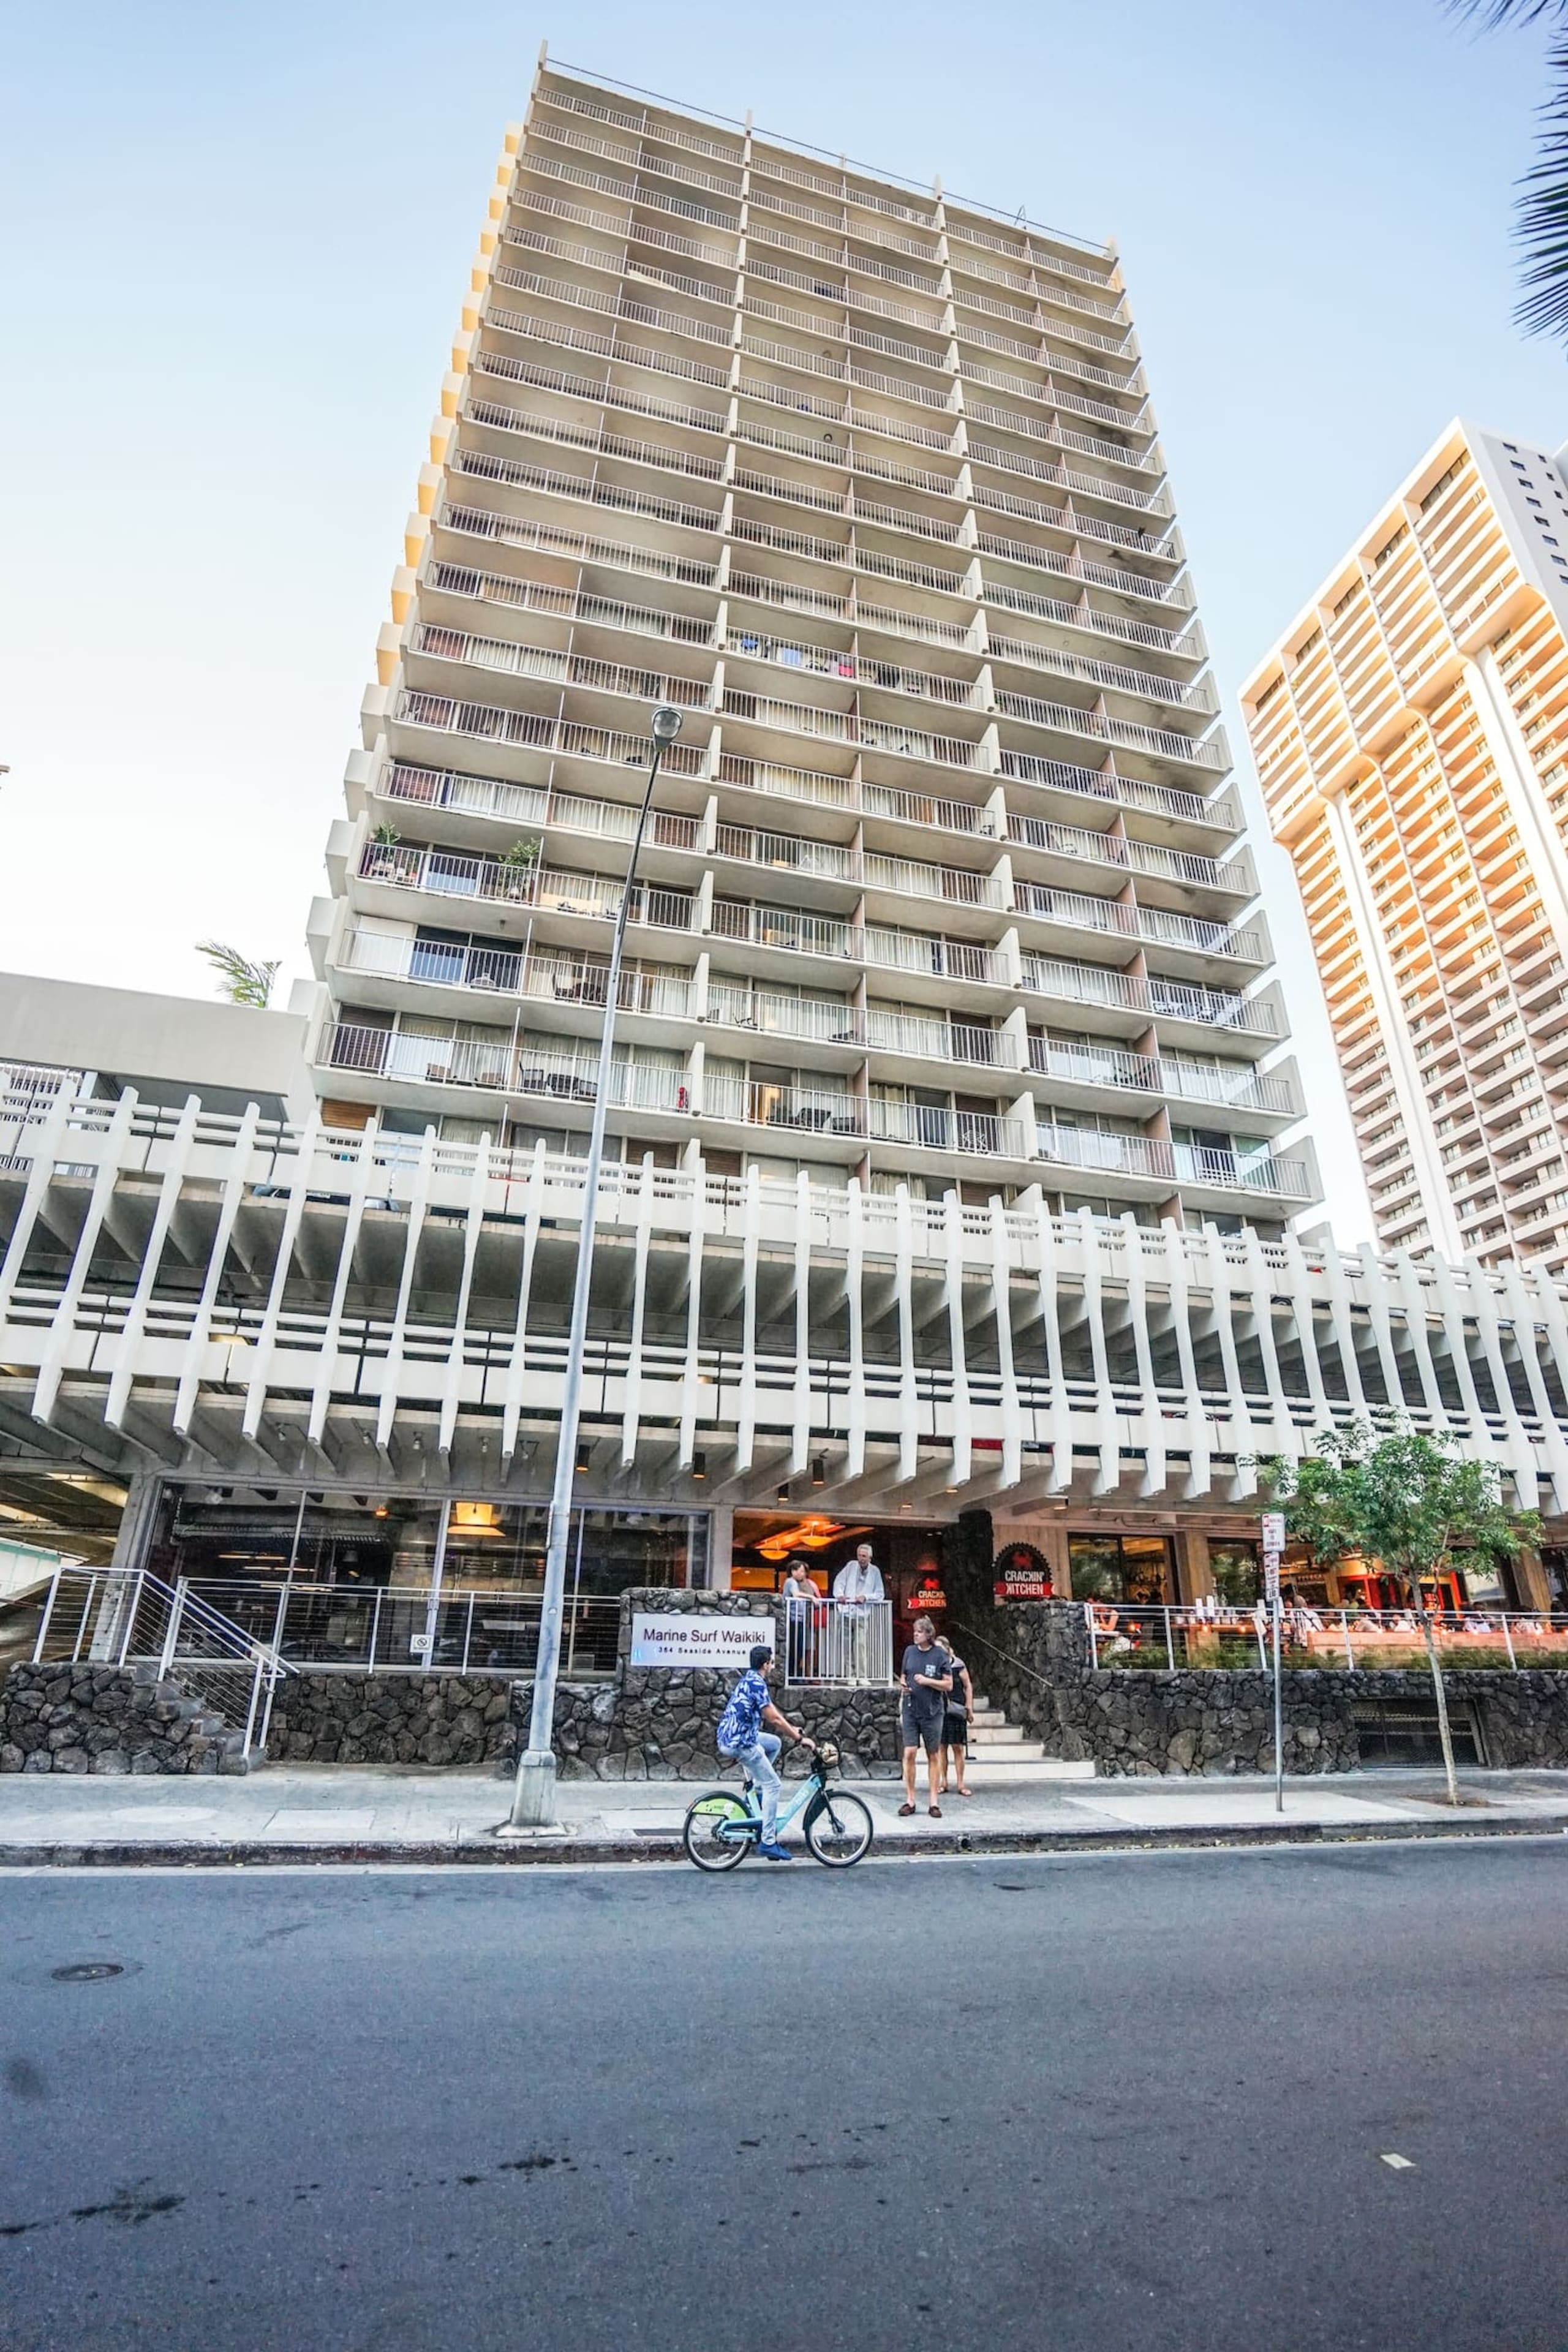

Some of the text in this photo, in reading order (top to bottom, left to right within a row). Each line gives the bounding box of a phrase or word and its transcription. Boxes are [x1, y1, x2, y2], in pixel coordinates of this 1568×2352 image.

[1005, 1570, 1045, 1582] CRACKIN'
[1006, 1583, 1044, 1595] KITCHEN
[644, 1629, 766, 1643] Marine Surf Waikiki
